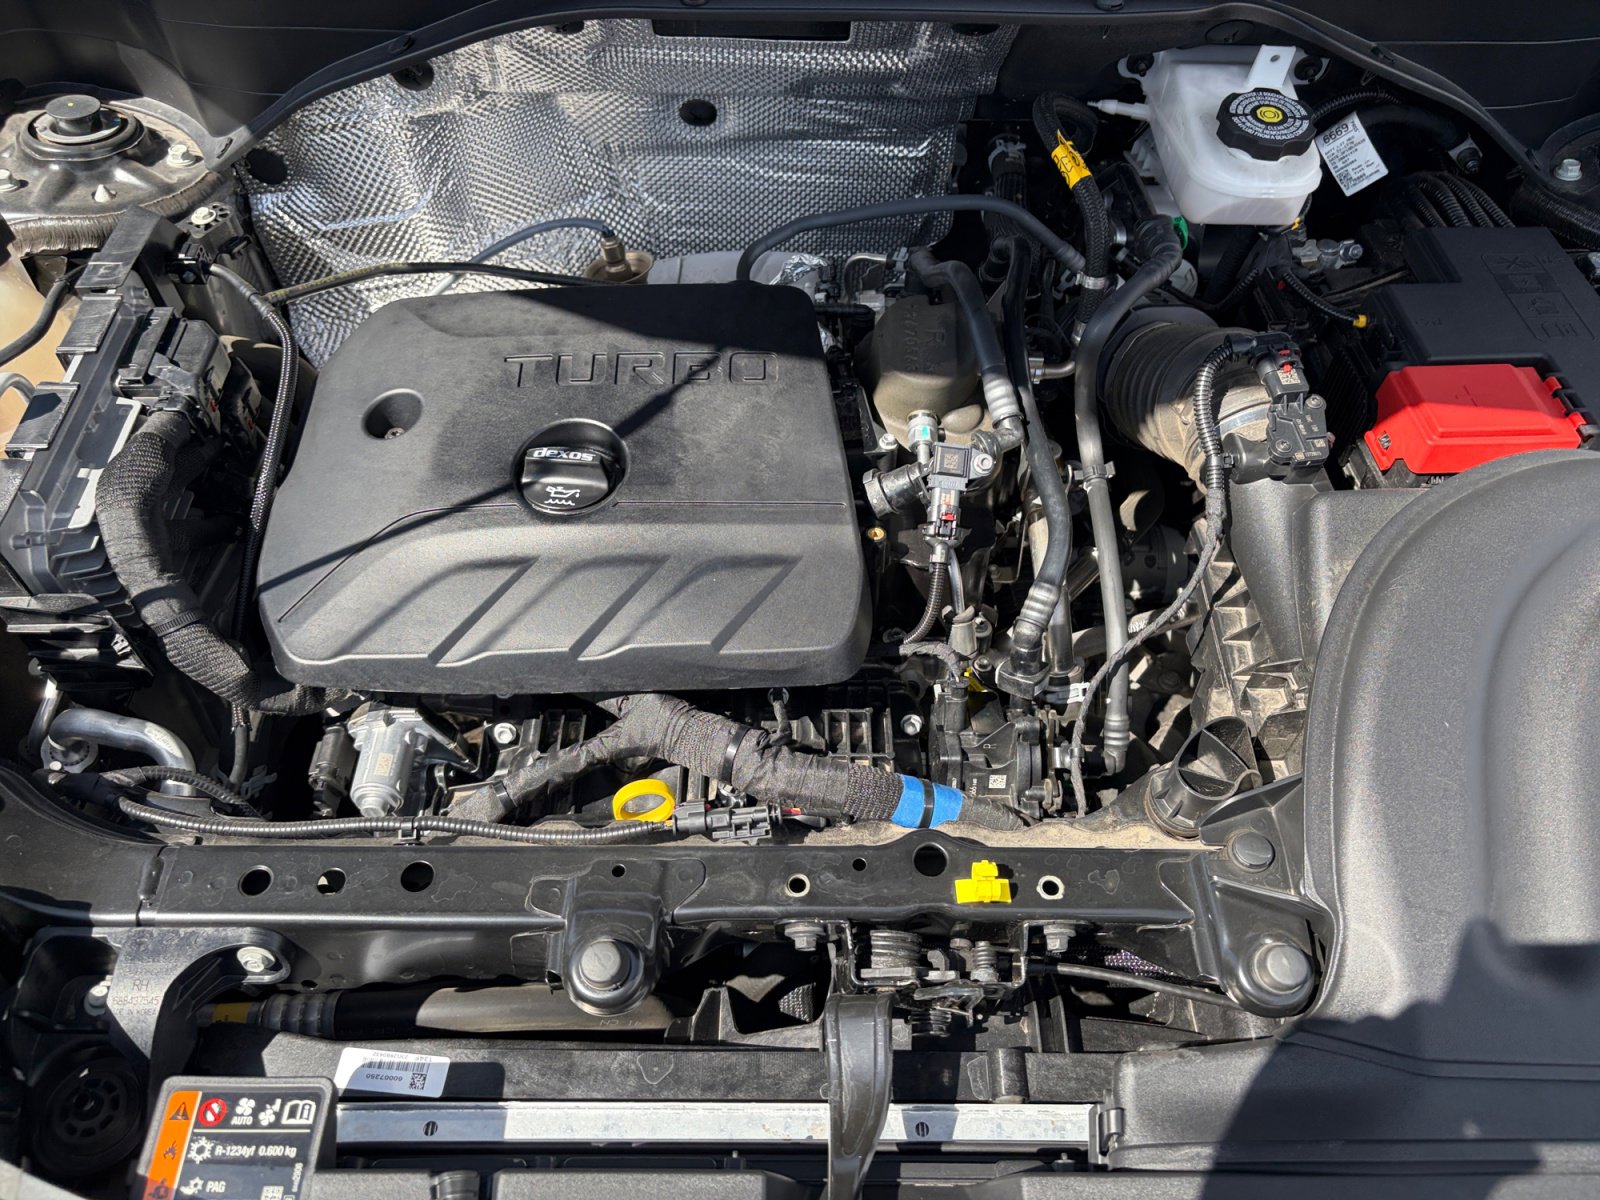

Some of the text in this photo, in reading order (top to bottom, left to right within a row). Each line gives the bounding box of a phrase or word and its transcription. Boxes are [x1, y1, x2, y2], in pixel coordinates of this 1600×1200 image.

[1322, 123, 1349, 143] 6669
[504, 351, 778, 387] TURBO
[533, 447, 596, 462] dexos
[132, 979, 149, 991] RH
[231, 1116, 253, 1125] AUTO
[214, 1145, 297, 1158] R-1234yf 0.600 kg
[205, 1180, 226, 1193] PAG
